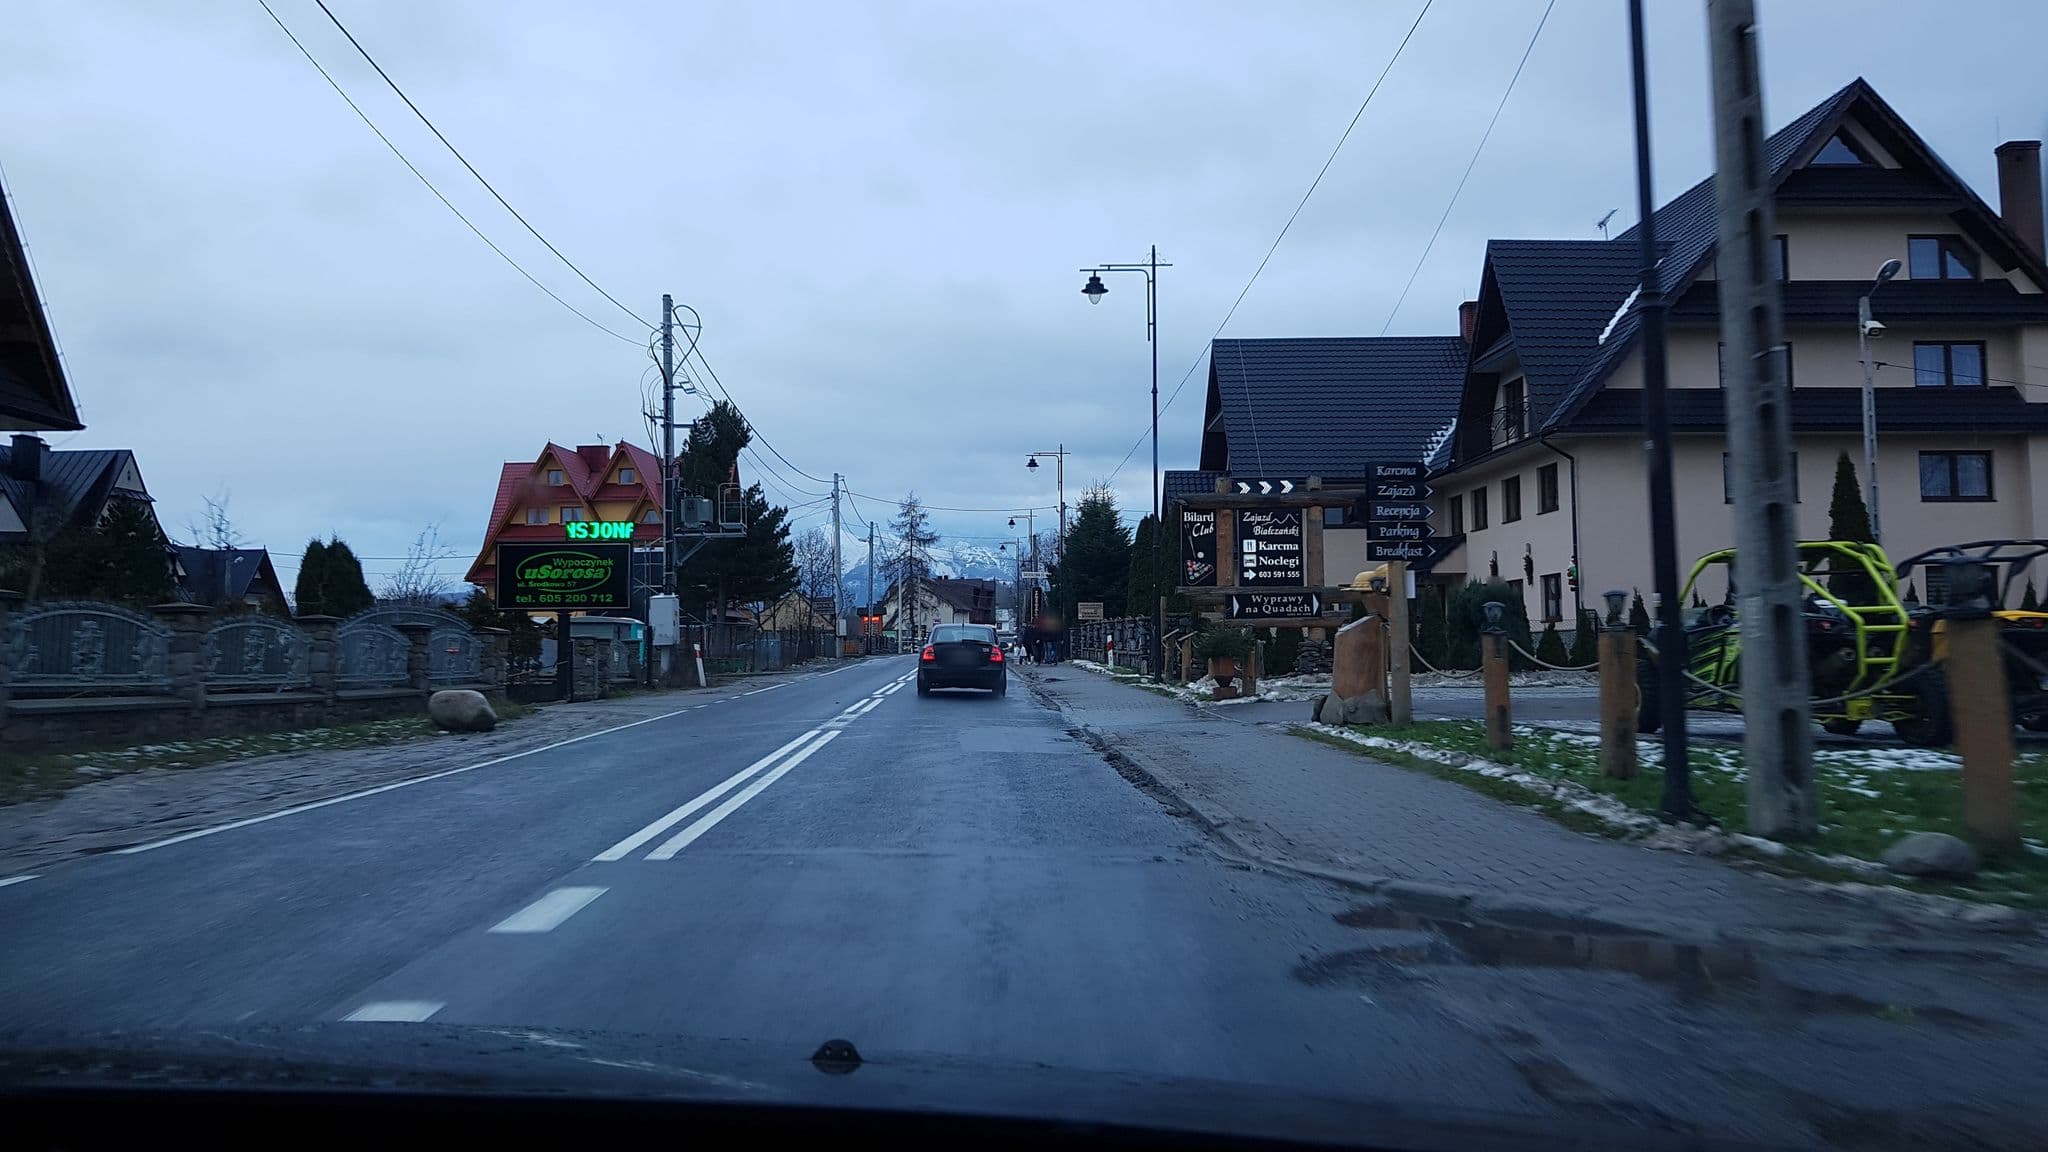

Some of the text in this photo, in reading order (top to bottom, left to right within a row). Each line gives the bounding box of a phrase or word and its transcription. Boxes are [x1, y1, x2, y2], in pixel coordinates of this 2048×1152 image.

[1376, 466, 1417, 476] Karcma
[1377, 485, 1416, 499] Zajazd
[1183, 511, 1214, 522] Bilard
[1376, 504, 1420, 519] Recepcja
[1242, 512, 1274, 525] Zajazd
[1192, 523, 1214, 537] Club
[1379, 523, 1420, 539] Parking
[1258, 541, 1299, 551] Karcma
[1376, 542, 1423, 559] Breakfast
[553, 558, 614, 568] Wypoczynek
[1258, 556, 1300, 568] Noclegi
[525, 565, 605, 579] uSorosa
[515, 593, 614, 603] tel. 605 200 712
[1251, 594, 1304, 605] Wyprawy
[1262, 604, 1311, 614] Quadach
